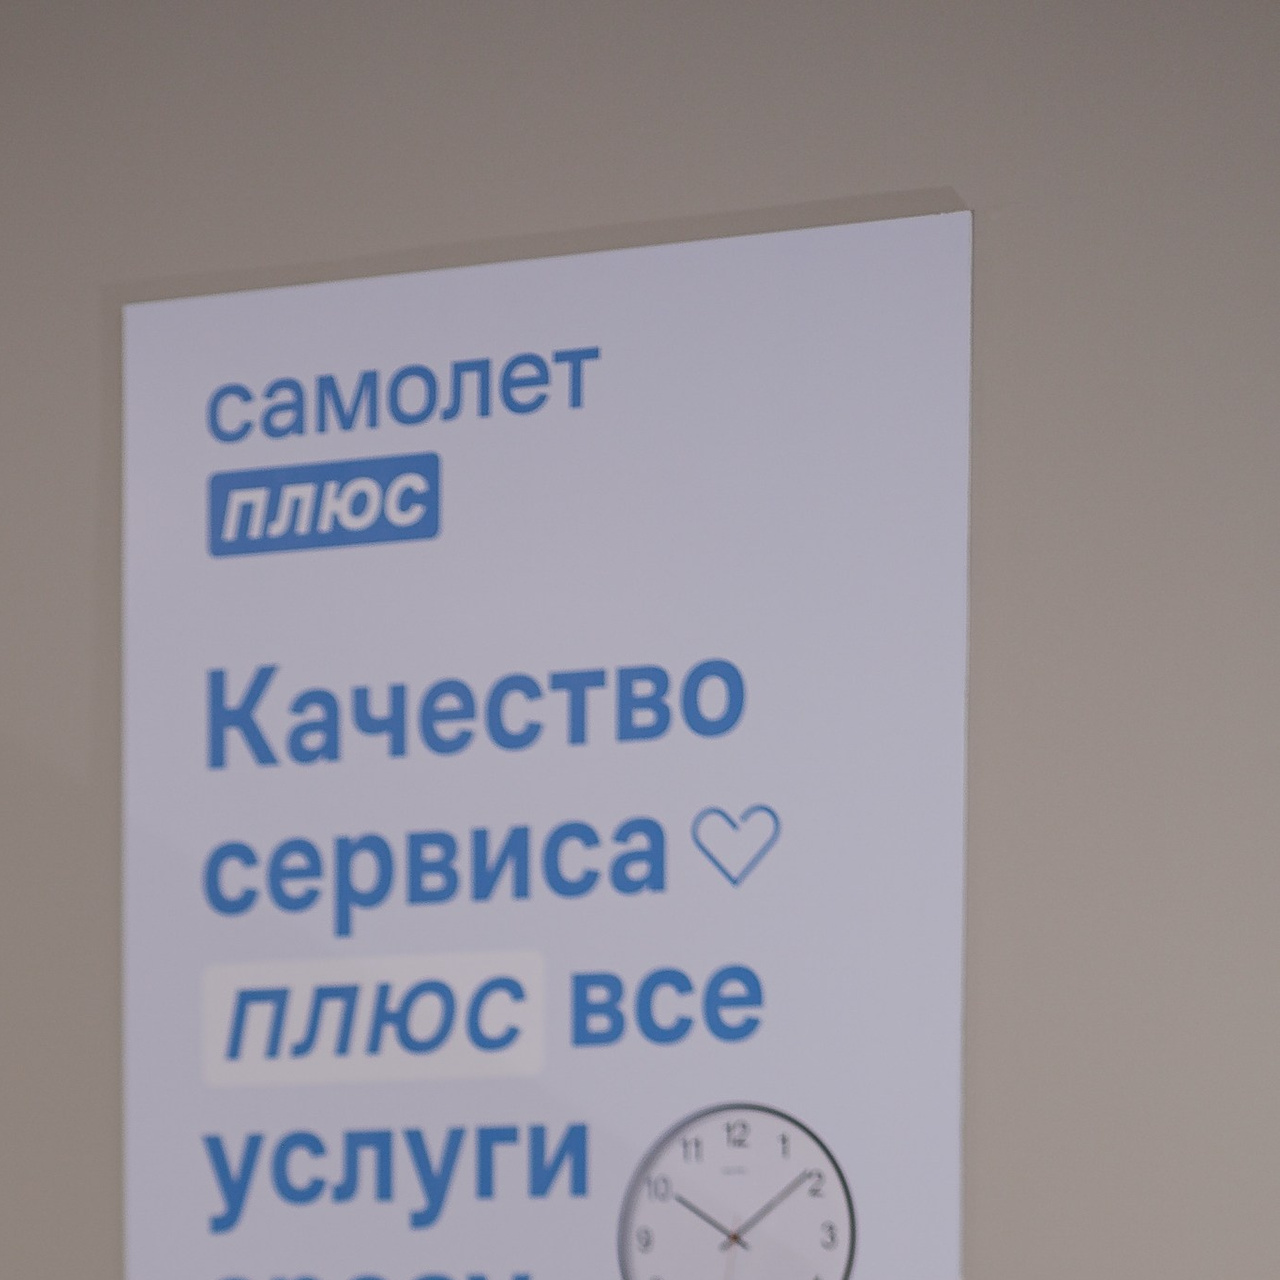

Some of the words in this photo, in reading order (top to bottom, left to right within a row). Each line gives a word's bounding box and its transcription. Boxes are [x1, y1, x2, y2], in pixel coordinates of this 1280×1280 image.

[207, 346, 601, 443] самолет
[221, 472, 429, 542] плюс
[206, 658, 747, 770] Качество
[202, 815, 667, 938] сервиса
[225, 975, 528, 1062] плюс
[570, 964, 764, 1048] все
[681, 1137, 703, 1163] 11
[724, 1120, 750, 1149] 12
[778, 1132, 790, 1159] 1
[203, 1122, 589, 1235] услуги
[644, 1173, 672, 1202] 10
[635, 1225, 654, 1254] 9
[821, 1222, 837, 1250] 3
